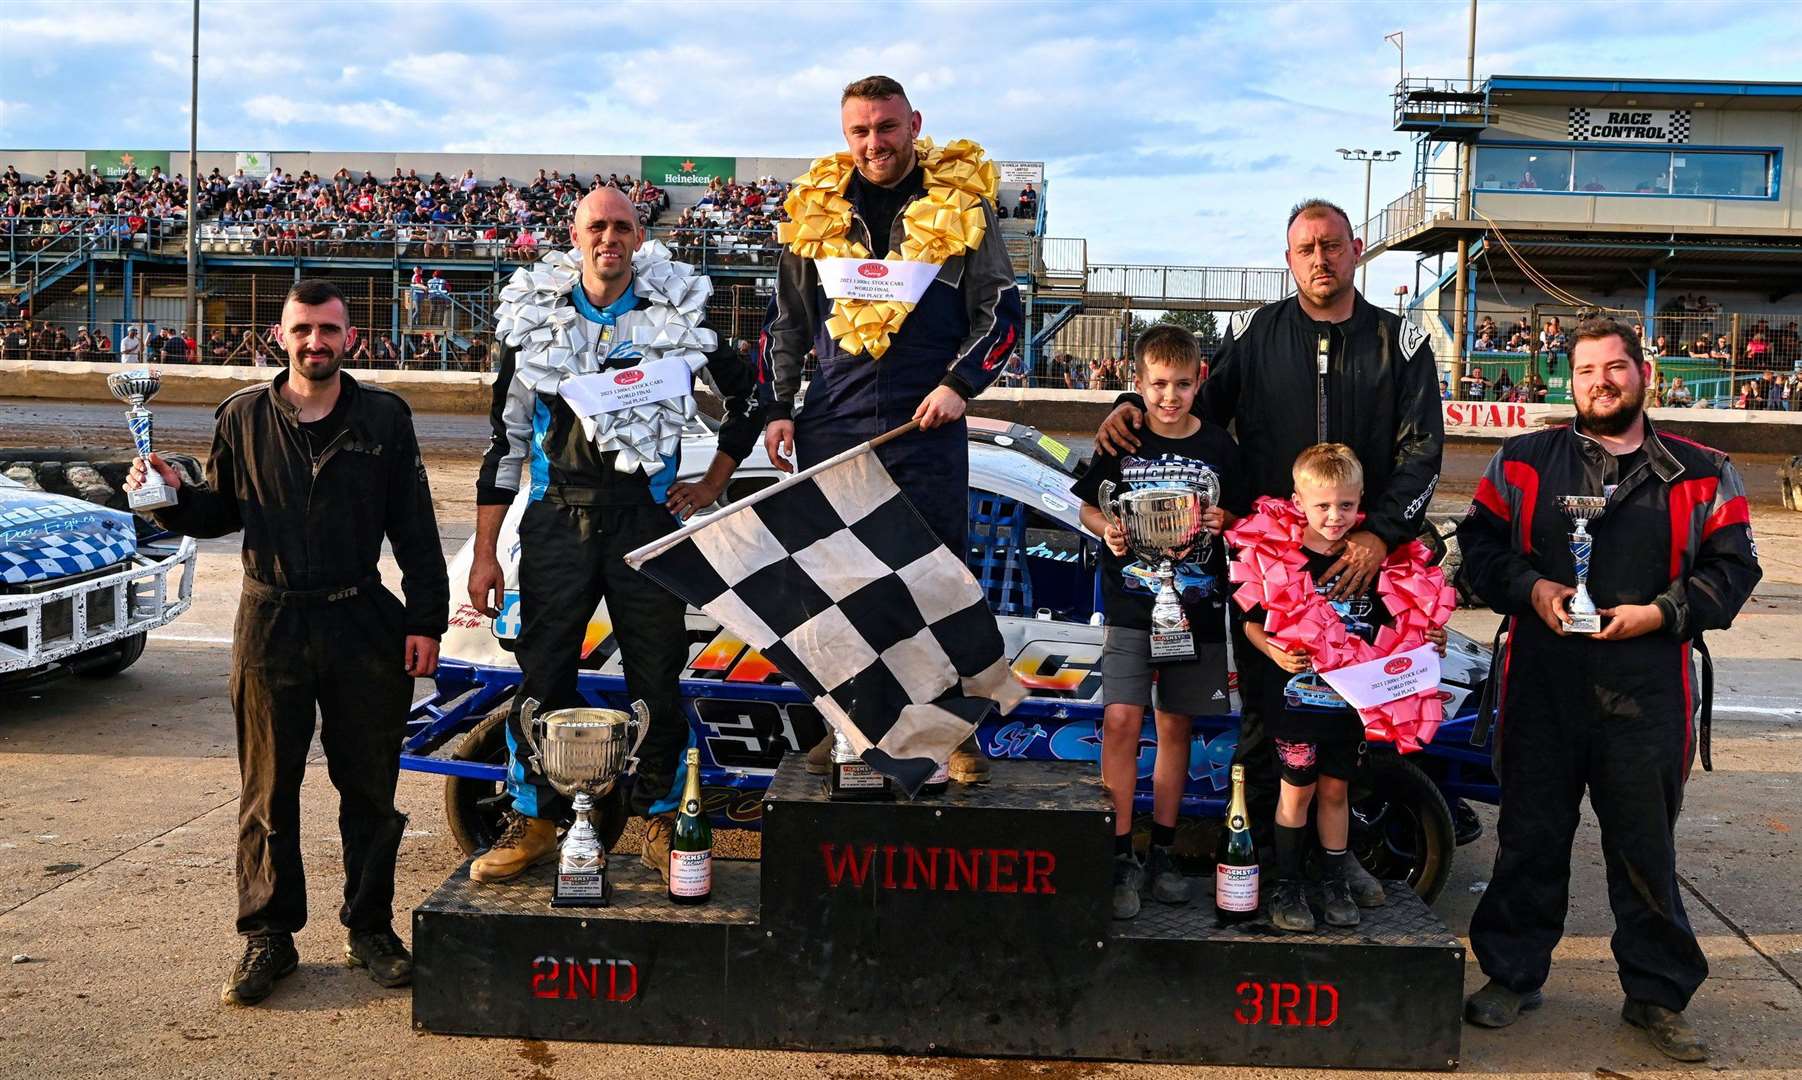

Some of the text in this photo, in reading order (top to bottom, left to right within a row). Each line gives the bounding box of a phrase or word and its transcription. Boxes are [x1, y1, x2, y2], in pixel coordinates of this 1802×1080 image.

[1608, 112, 1652, 125] RACE
[1591, 125, 1666, 139] CONTROL
[665, 173, 710, 184] Heineken
[631, 382, 649, 391] STOCK
[649, 379, 664, 387] CARS
[616, 389, 653, 400] WORLD FINAL
[632, 396, 648, 404] PLACE
[1446, 403, 1527, 428] STAR
[1400, 672, 1415, 682] STOCK
[1415, 667, 1428, 675] CARS
[1387, 679, 1418, 692] WORLD FINAL
[1401, 687, 1416, 696] PLACE
[820, 842, 1057, 894] WINNER
[530, 954, 639, 1003] 2ND
[1233, 981, 1339, 1027] 3RD
